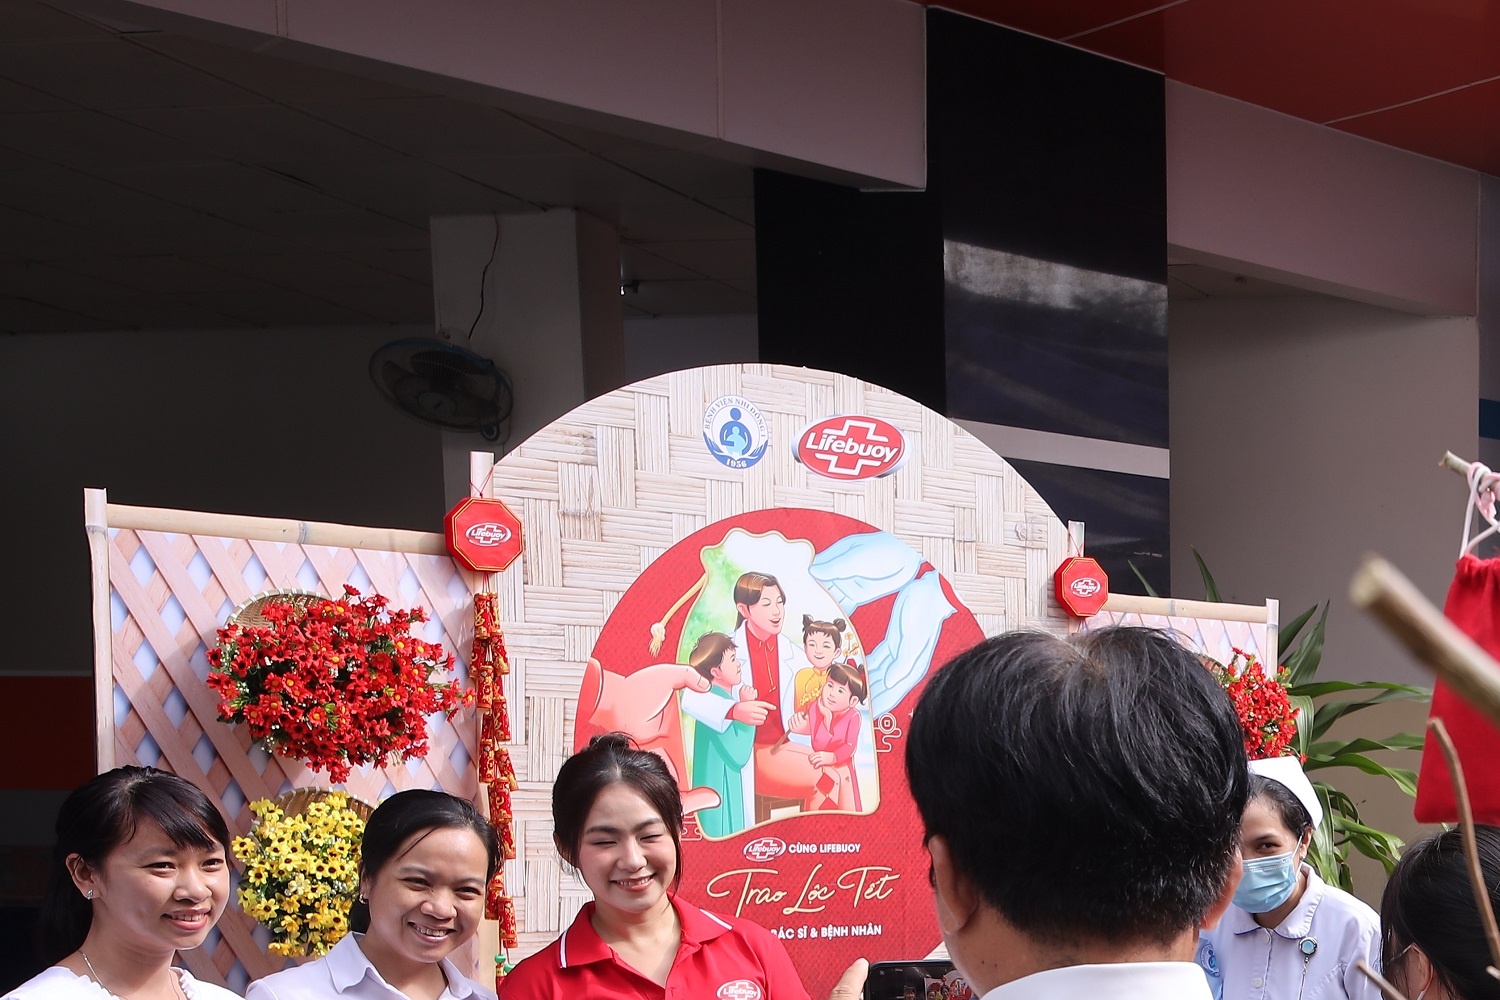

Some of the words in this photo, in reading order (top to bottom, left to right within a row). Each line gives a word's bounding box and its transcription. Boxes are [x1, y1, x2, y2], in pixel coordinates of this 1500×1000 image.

[805, 431, 899, 464] Lifebuoy
[726, 458, 748, 468] 1956
[471, 529, 505, 538] Lifebuoy
[748, 844, 782, 855] Lifebuoy
[788, 841, 818, 854] CÙNG
[819, 842, 861, 854] LIFEBUOY
[706, 867, 787, 919] Trao
[782, 863, 835, 916] Lộc
[836, 865, 901, 908] Tết
[797, 925, 808, 939] SĨ
[810, 927, 819, 938] &
[820, 924, 849, 941] BỆNH
[851, 922, 882, 937] NHÂN
[723, 987, 758, 997] Lifebuoy
